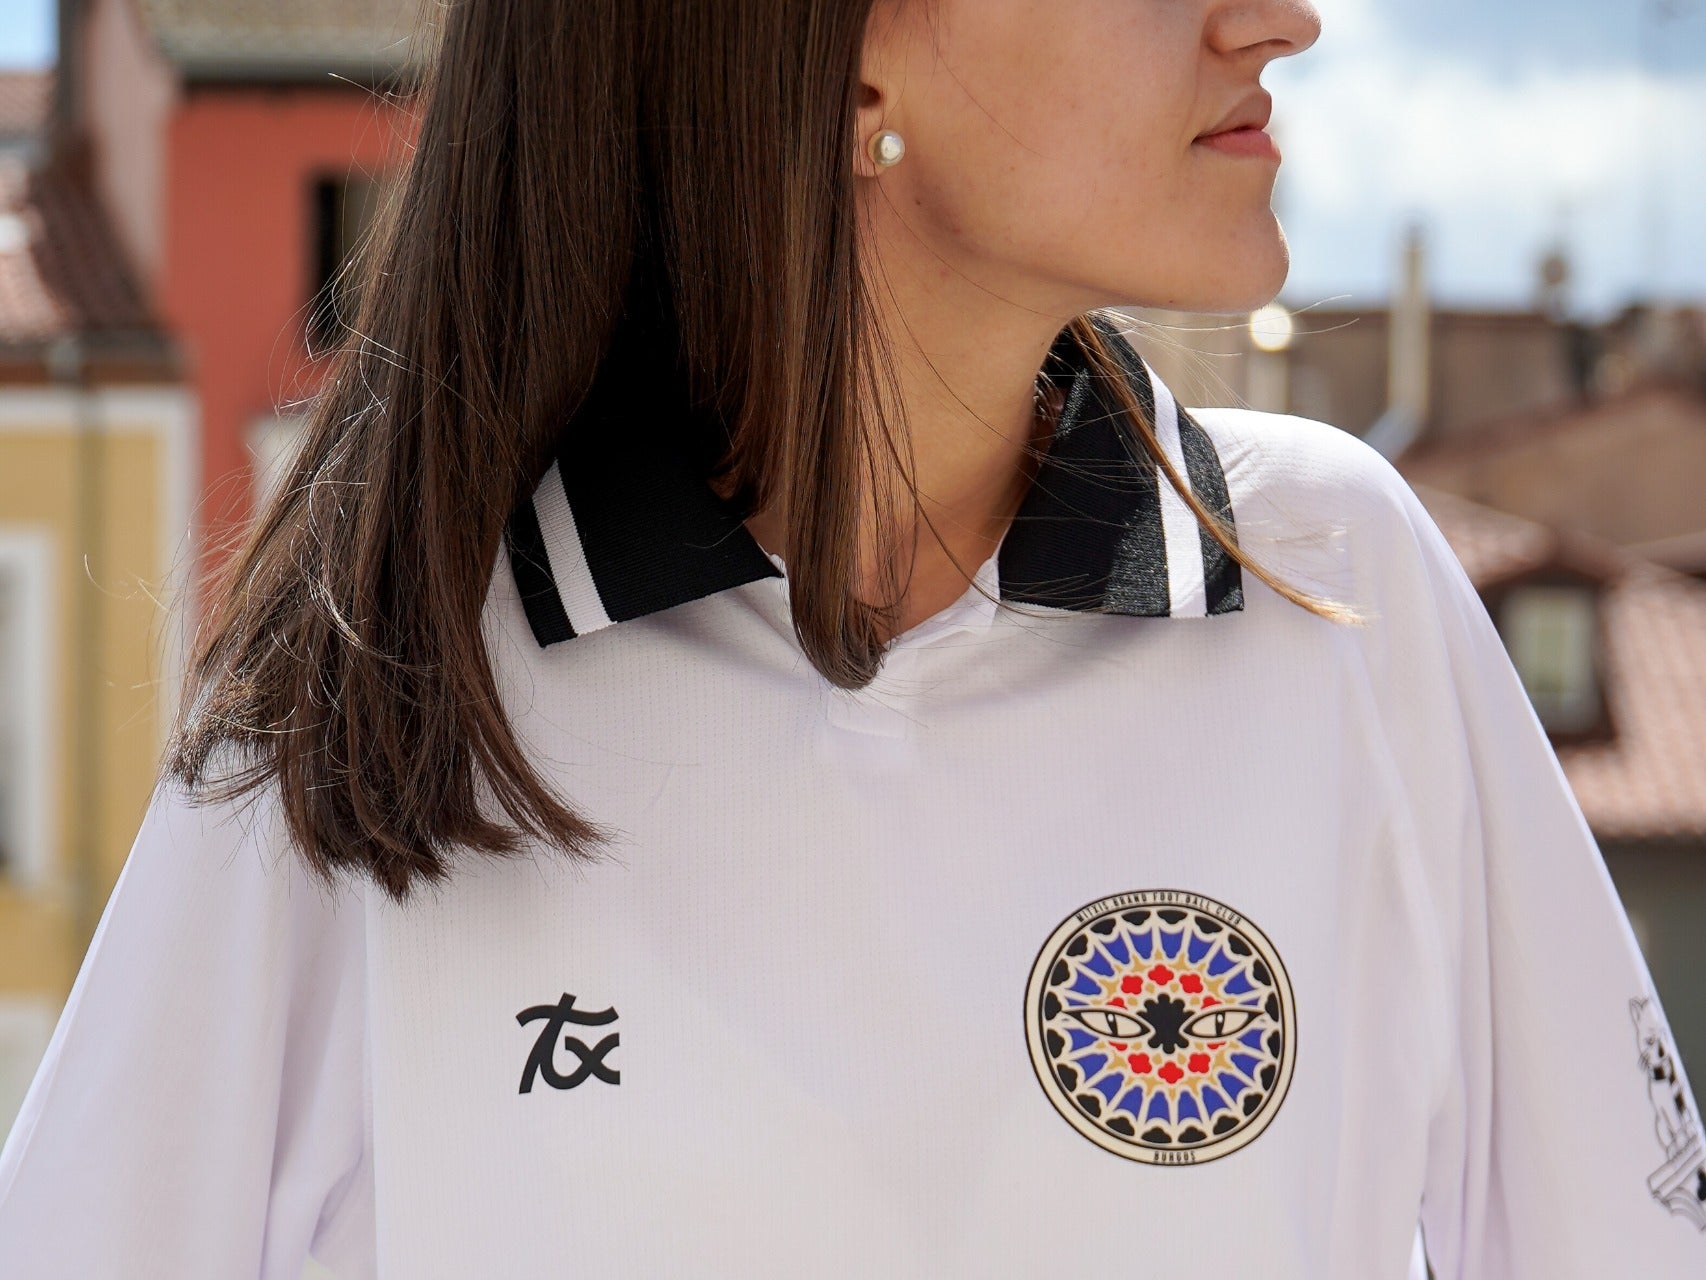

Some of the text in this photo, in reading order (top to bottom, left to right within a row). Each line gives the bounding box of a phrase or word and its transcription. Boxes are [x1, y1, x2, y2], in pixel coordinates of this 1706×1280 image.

[1113, 893, 1146, 907] BRAND
[1216, 905, 1242, 925] CLUB
[1154, 1151, 1196, 1162] BURGOS
